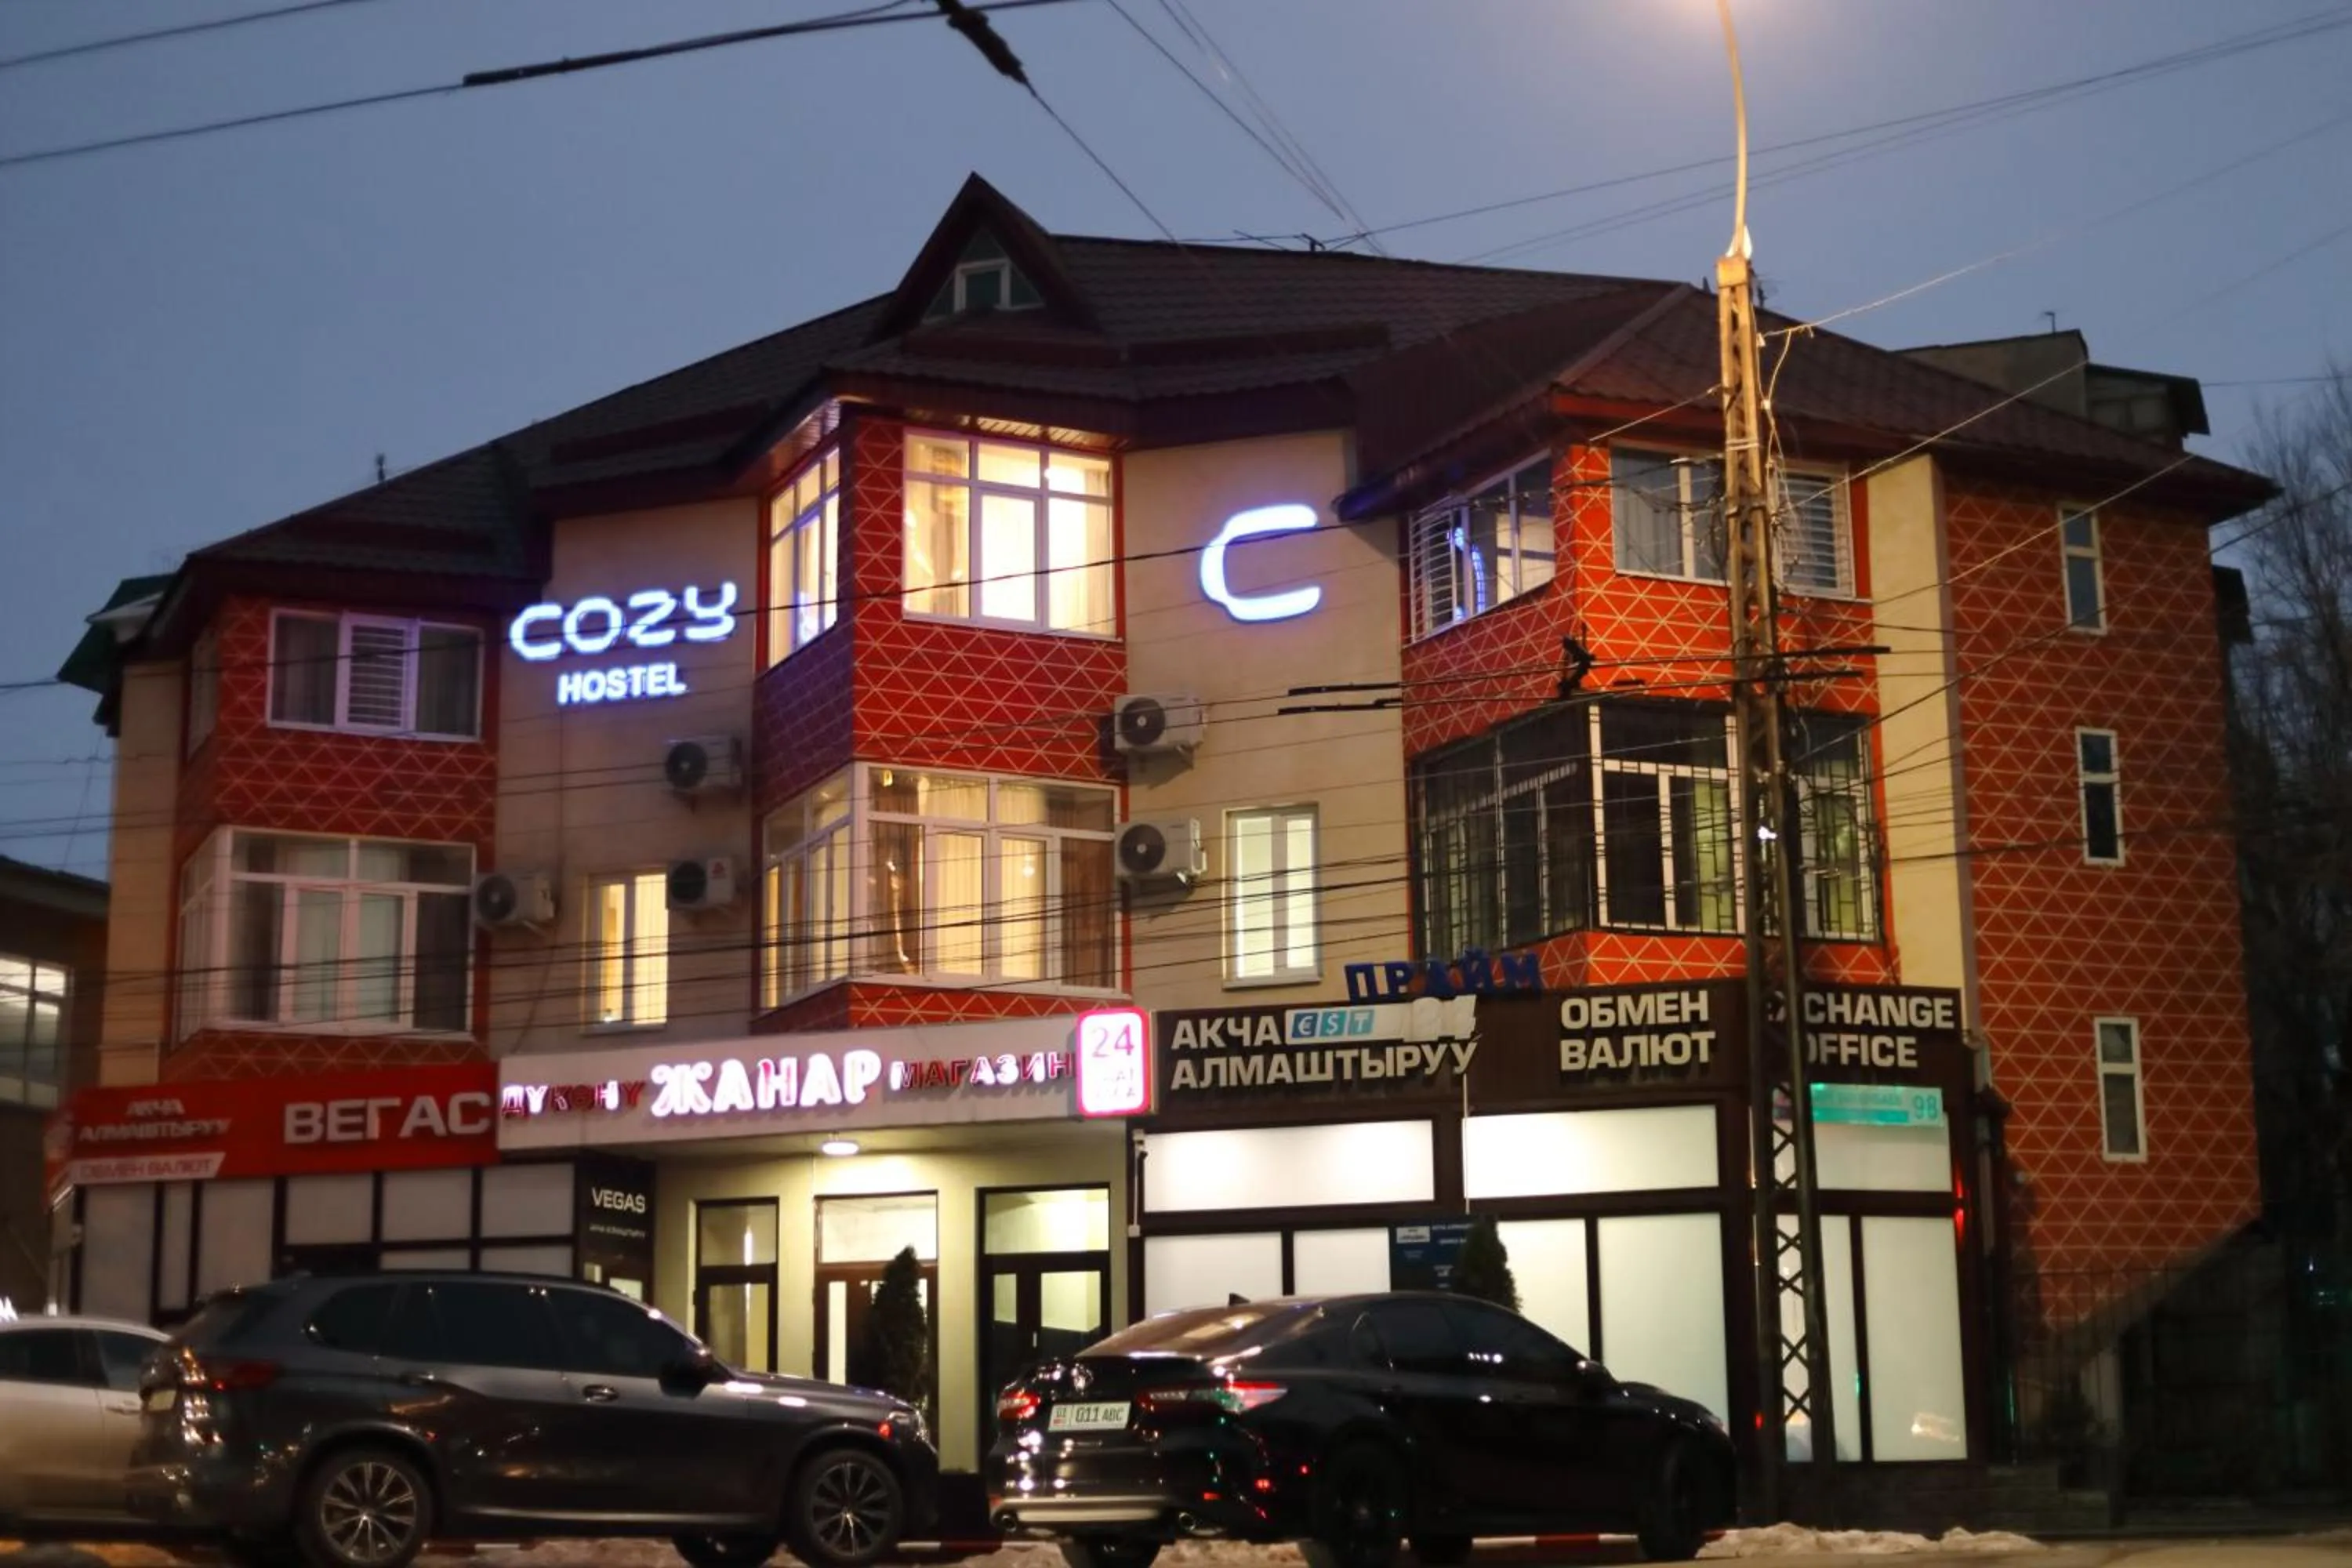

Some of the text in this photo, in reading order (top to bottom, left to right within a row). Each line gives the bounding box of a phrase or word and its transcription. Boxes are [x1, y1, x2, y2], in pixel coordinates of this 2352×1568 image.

[510, 582, 737, 660] COZY
[557, 662, 688, 705] HOSTEL
[1561, 990, 1710, 1029] ОБМЕН
[1091, 1023, 1134, 1058] 24
[1171, 1015, 1283, 1051] АКЧА
[1560, 1031, 1716, 1072] ВАЛЮТ
[651, 1049, 882, 1117] ЖАНАР
[890, 1051, 1073, 1091] МАГАЗИН
[1171, 1040, 1479, 1091] АЛМАШТЫРУУ
[284, 1092, 489, 1144] ВЕГАС
[592, 1187, 646, 1214] VEGAS
